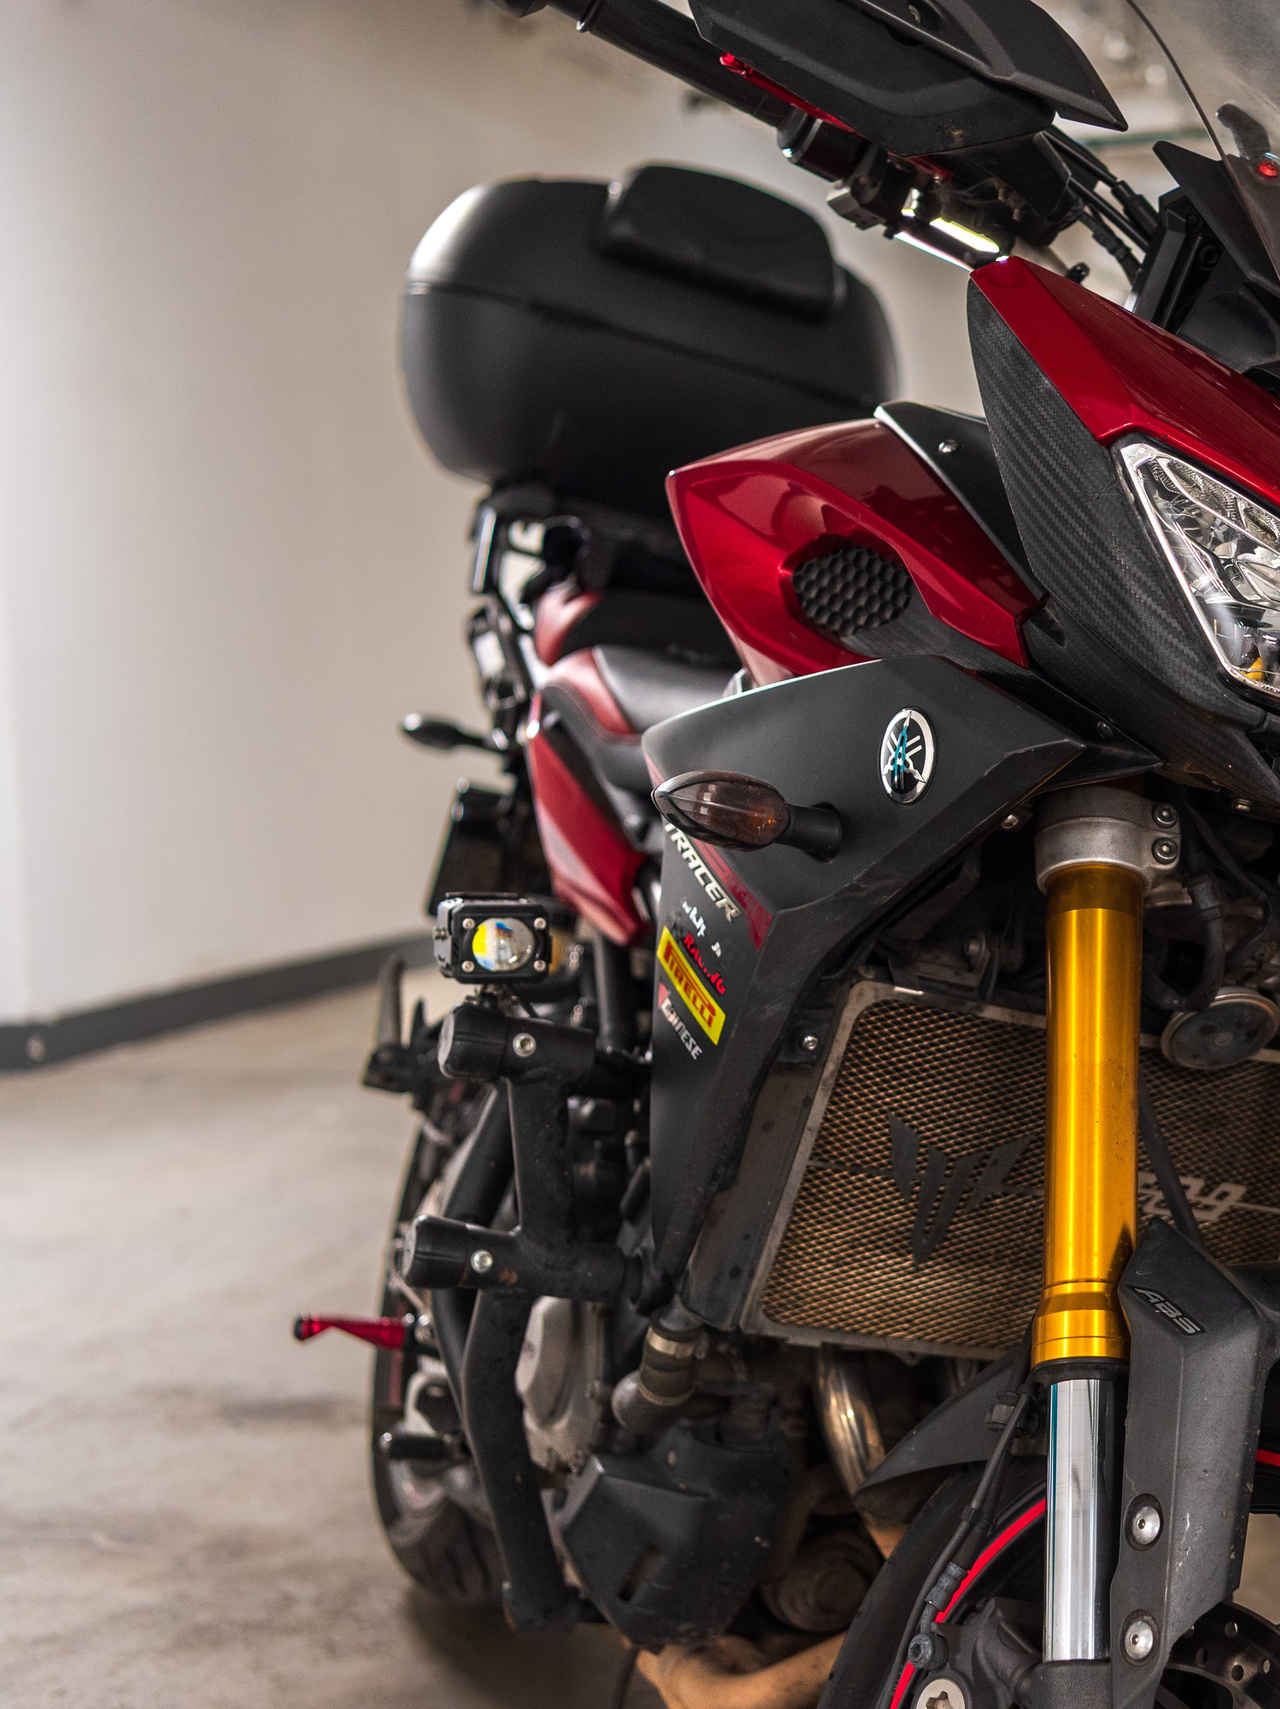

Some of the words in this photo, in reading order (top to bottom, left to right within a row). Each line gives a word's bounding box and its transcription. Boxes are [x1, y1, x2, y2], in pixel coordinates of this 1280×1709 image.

[664, 822, 742, 923] TRACER
[663, 939, 717, 1029] PIRELLI
[683, 932, 726, 995] RACNG
[1134, 1287, 1202, 1334] ABS
